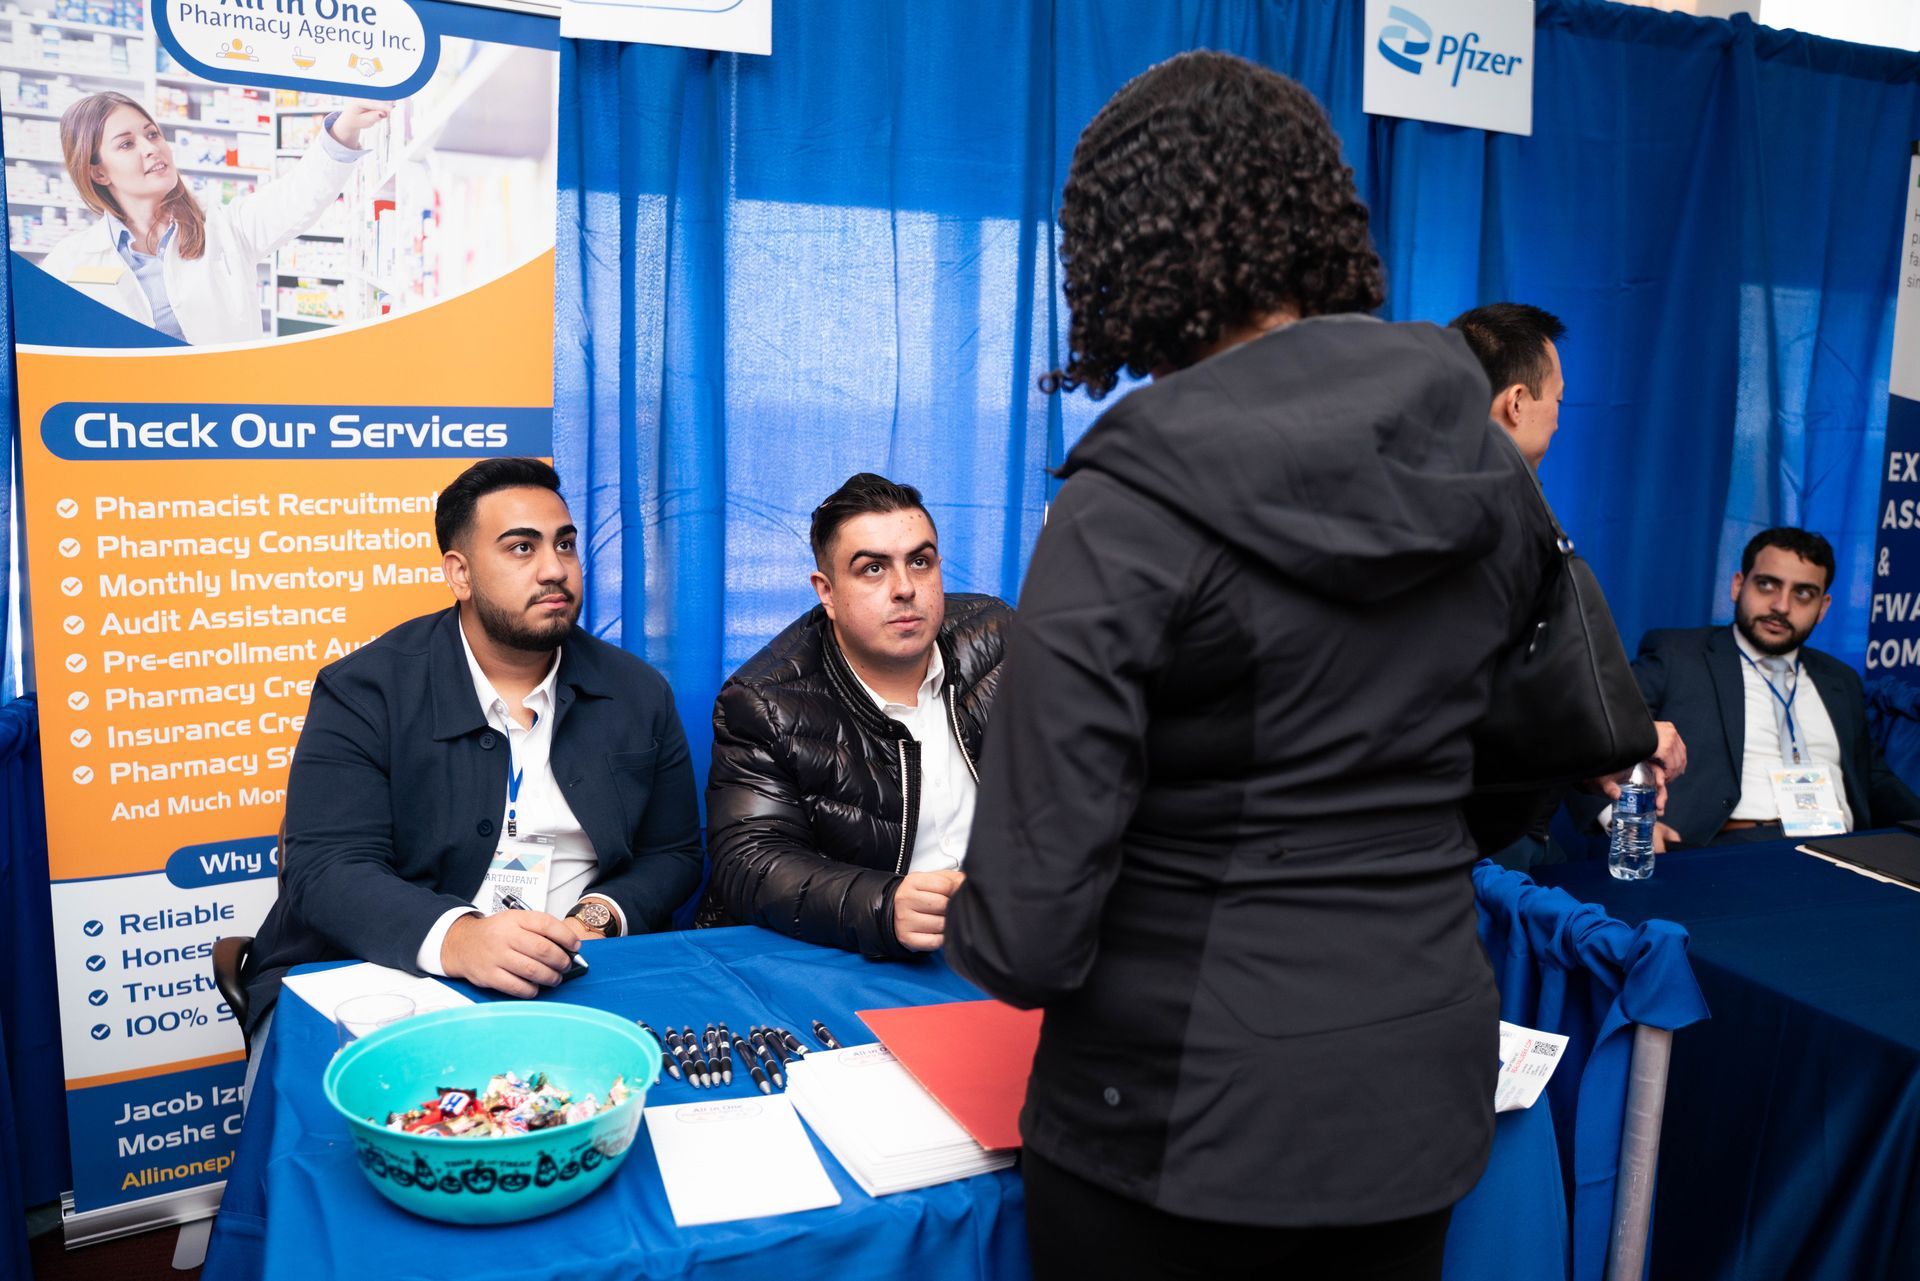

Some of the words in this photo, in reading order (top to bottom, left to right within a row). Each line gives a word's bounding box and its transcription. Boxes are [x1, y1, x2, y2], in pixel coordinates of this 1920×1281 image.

[179, 3, 291, 39] Pharmacy
[298, 19, 375, 51] Agency
[382, 30, 416, 52] Inc.
[315, 0, 377, 25] One
[1436, 32, 1523, 88] Pfizer
[74, 412, 219, 448] Check
[231, 413, 316, 448] Our
[329, 414, 508, 448] Services
[95, 494, 270, 520] Pharmacist
[278, 491, 438, 517] Recruitment
[97, 535, 250, 559] Pharmacy
[258, 528, 431, 553] Consultation
[1877, 546, 1890, 577] &
[99, 570, 221, 598] Monthly
[231, 567, 364, 592] Inventory
[372, 563, 450, 586] Mana
[100, 609, 182, 636] Audit
[188, 604, 347, 632] Assistance
[103, 638, 317, 674] Pre-enrollment
[323, 635, 378, 660] Au
[105, 682, 255, 711] Pharmacy
[263, 676, 316, 698] Cre
[107, 719, 251, 748] Insurance
[109, 753, 258, 785] Pharmacy
[111, 798, 160, 822] And
[167, 791, 231, 815] Much
[199, 851, 262, 875] Why
[119, 901, 235, 935] Reliable
[121, 935, 220, 970] Hones
[125, 1006, 208, 1038] 100%
[114, 1090, 204, 1126] Jacob
[118, 1123, 216, 1158] Moshe
[121, 1150, 236, 1191] Allinonep
